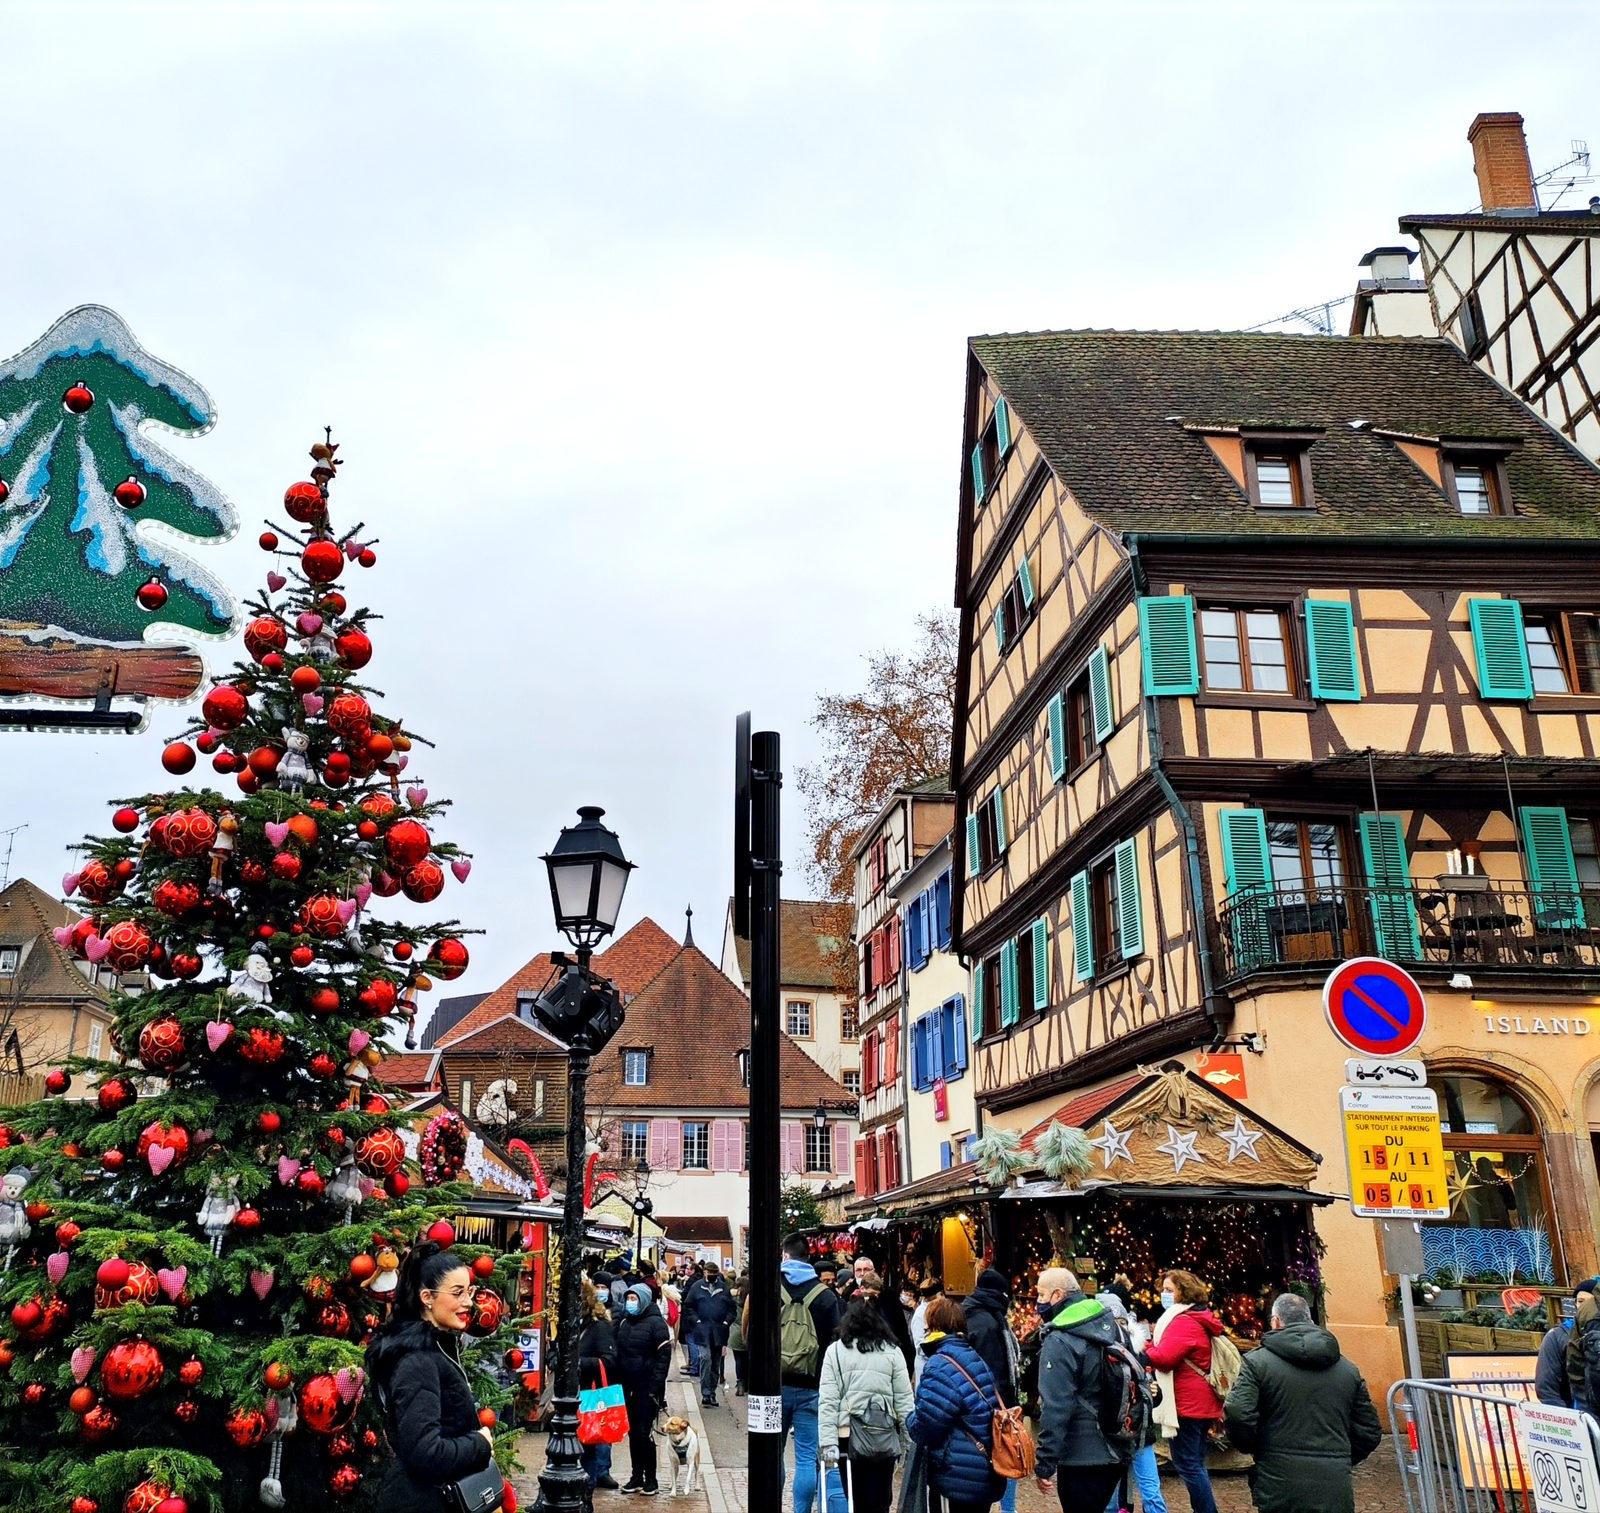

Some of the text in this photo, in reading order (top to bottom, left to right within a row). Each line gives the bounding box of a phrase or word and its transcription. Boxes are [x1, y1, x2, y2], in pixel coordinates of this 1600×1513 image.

[1485, 1016, 1591, 1035] ISLAND
[1347, 1113, 1404, 1122] STATIONNEMENT
[1355, 1123, 1369, 1131] SUR
[1385, 1135, 1403, 1146] DU
[1389, 1172, 1407, 1182] AU
[1542, 1413, 1577, 1426] RESTAURATION
[1532, 1422, 1540, 1430] EAT
[1546, 1425, 1559, 1434] DRINK
[1560, 1428, 1572, 1437] ZONE
